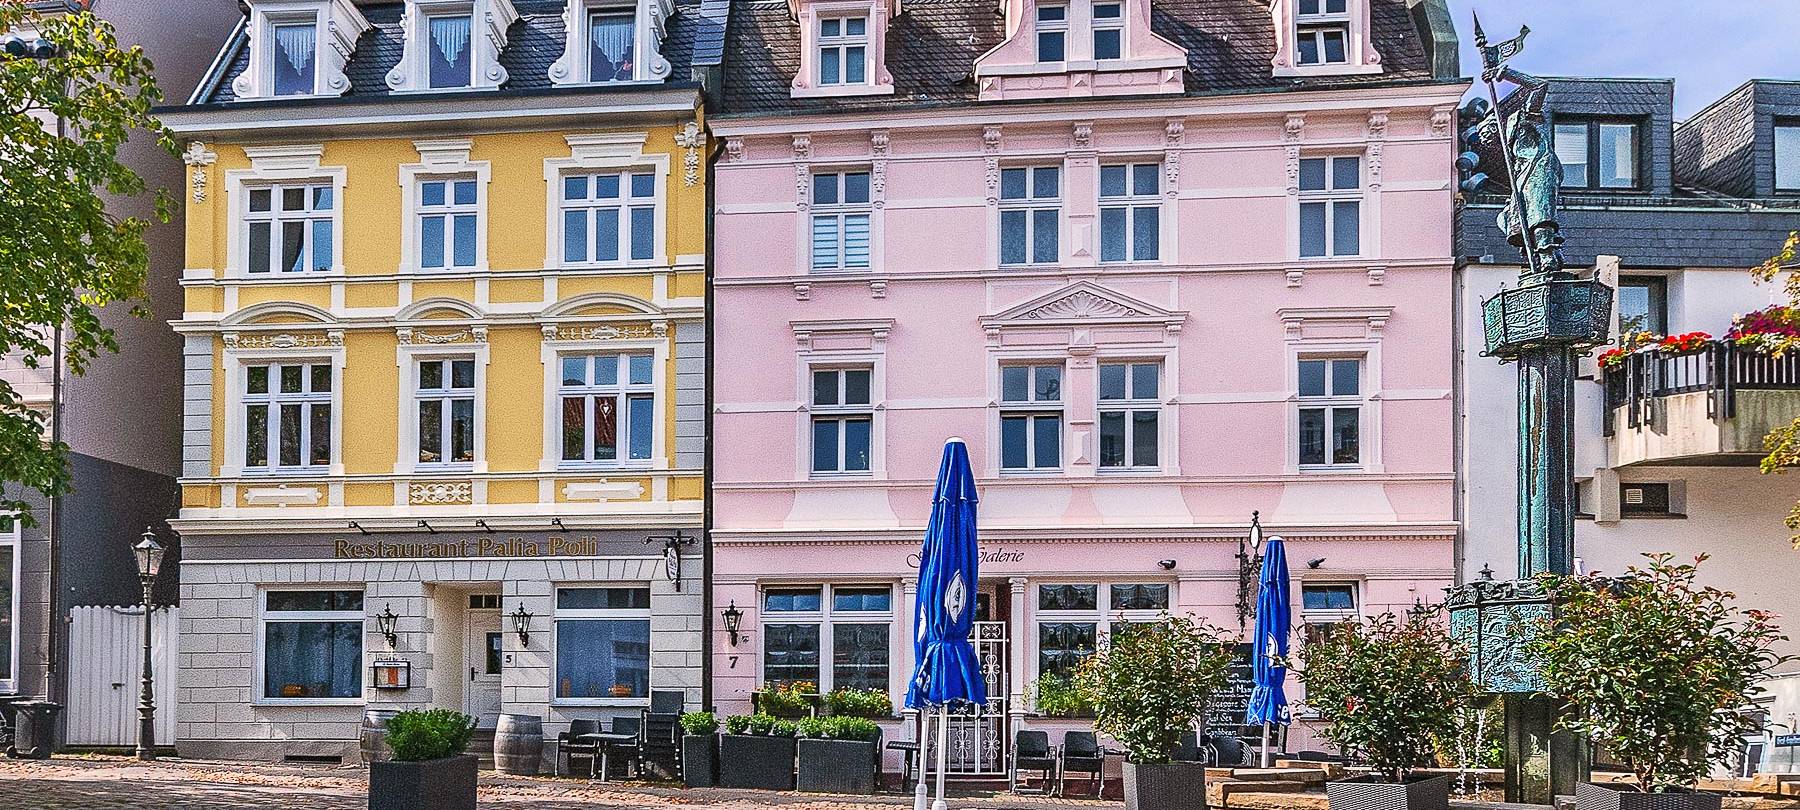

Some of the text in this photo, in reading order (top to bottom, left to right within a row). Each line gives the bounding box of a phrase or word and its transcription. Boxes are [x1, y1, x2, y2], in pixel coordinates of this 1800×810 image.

[334, 536, 598, 559] Restaurant Palia Poli
[505, 654, 513, 664] 5
[729, 656, 739, 669] 7
